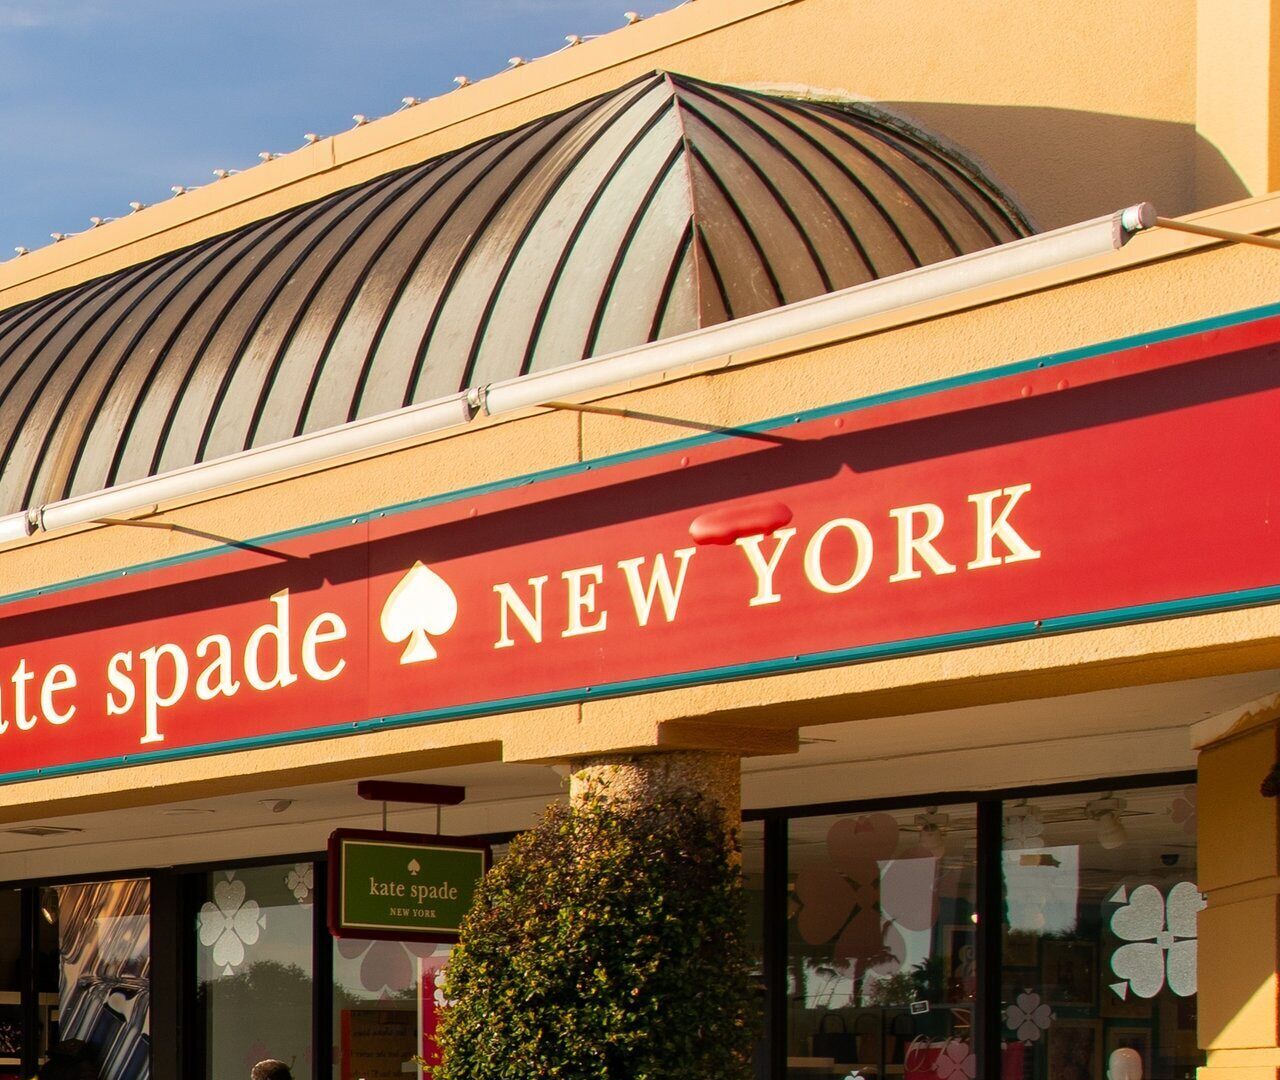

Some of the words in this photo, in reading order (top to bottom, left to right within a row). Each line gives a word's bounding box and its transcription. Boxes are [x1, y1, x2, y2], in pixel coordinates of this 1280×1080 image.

[106, 588, 348, 743] spade
[492, 547, 696, 649] NEW
[735, 483, 1041, 607] YORK
[369, 877, 405, 897] kate
[410, 881, 458, 904] spade
[389, 907, 410, 918] NEW
[412, 908, 437, 918] YORK
